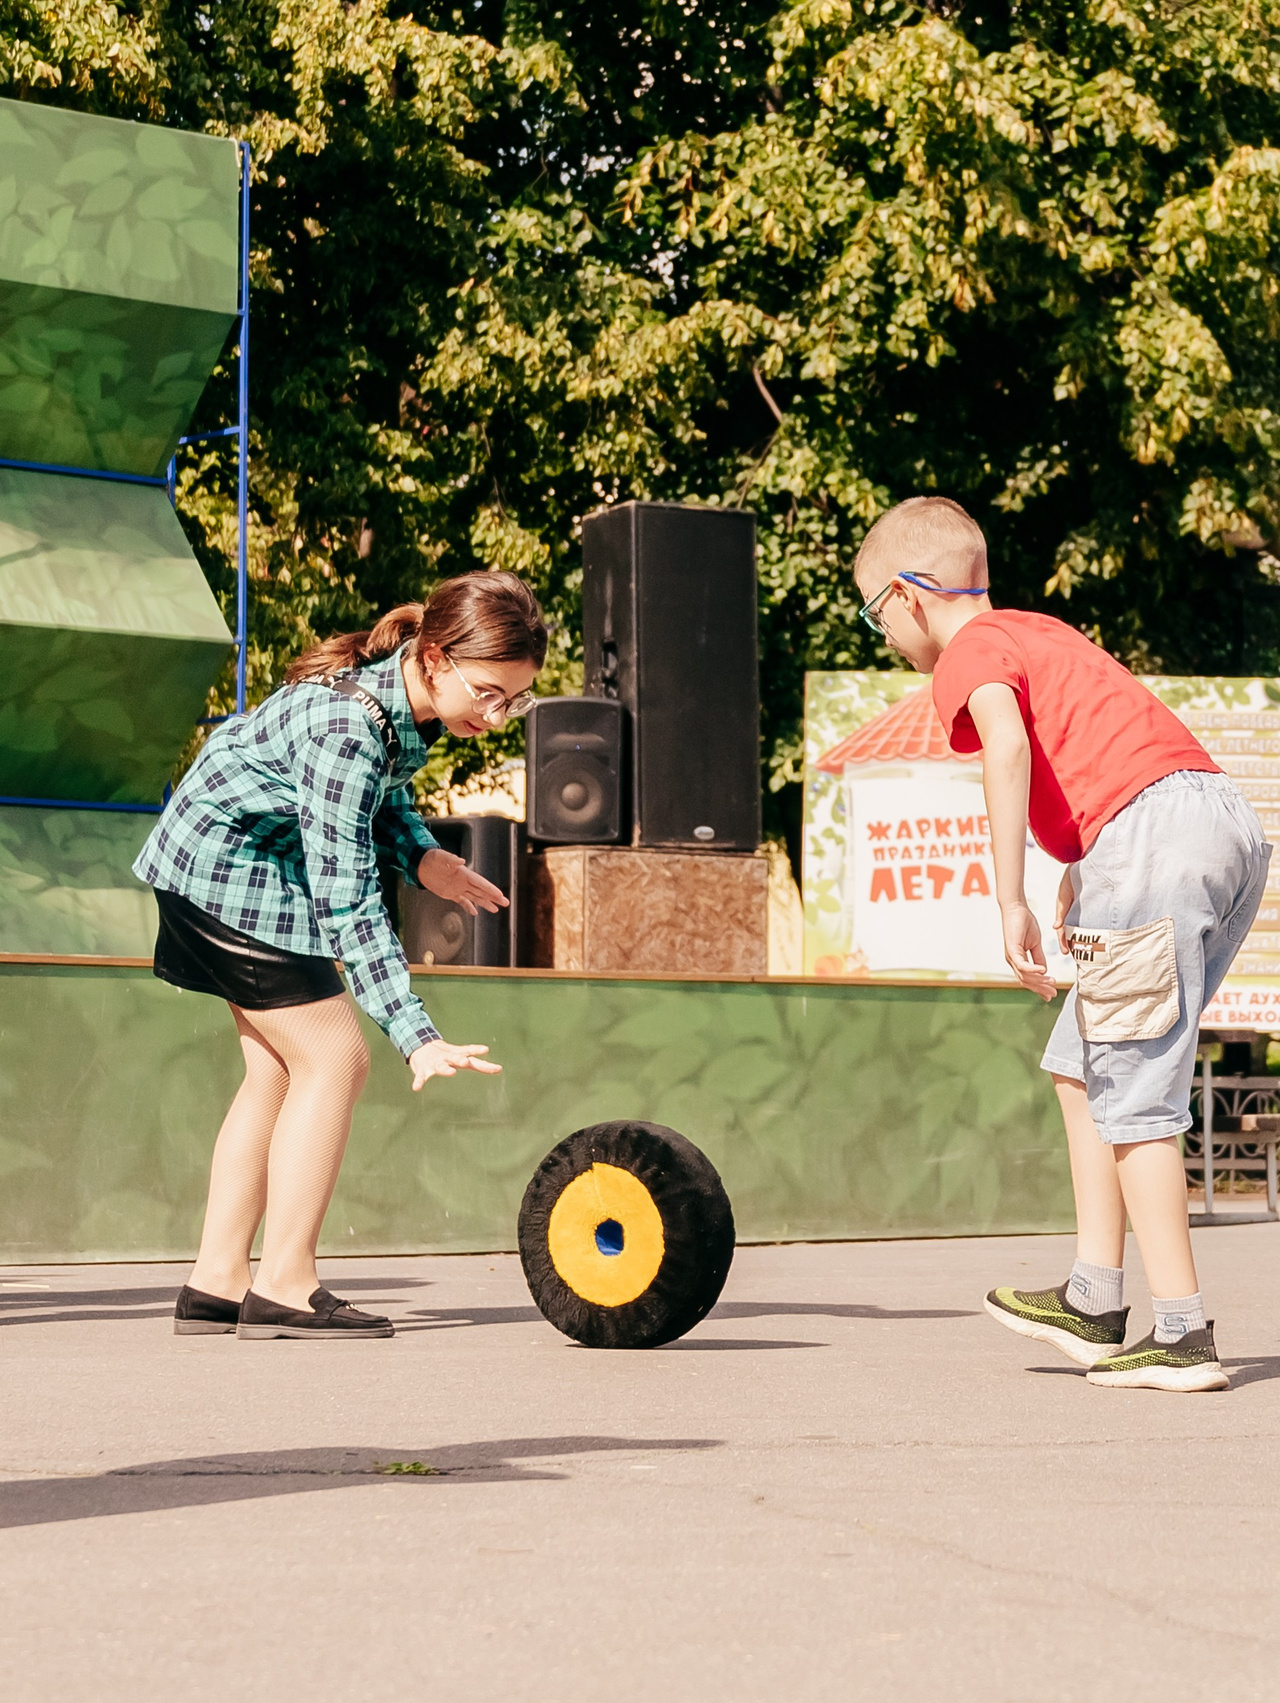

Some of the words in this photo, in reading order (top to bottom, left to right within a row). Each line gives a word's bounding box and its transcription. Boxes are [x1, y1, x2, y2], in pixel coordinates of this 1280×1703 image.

[352, 690, 387, 731] PUMA
[1225, 738, 1280, 753] ЛЕТНЕГО
[866, 815, 989, 841] ЖАРКИЕ
[873, 842, 993, 862] ПРАЗДНИК
[869, 862, 991, 903] ЛЕТА
